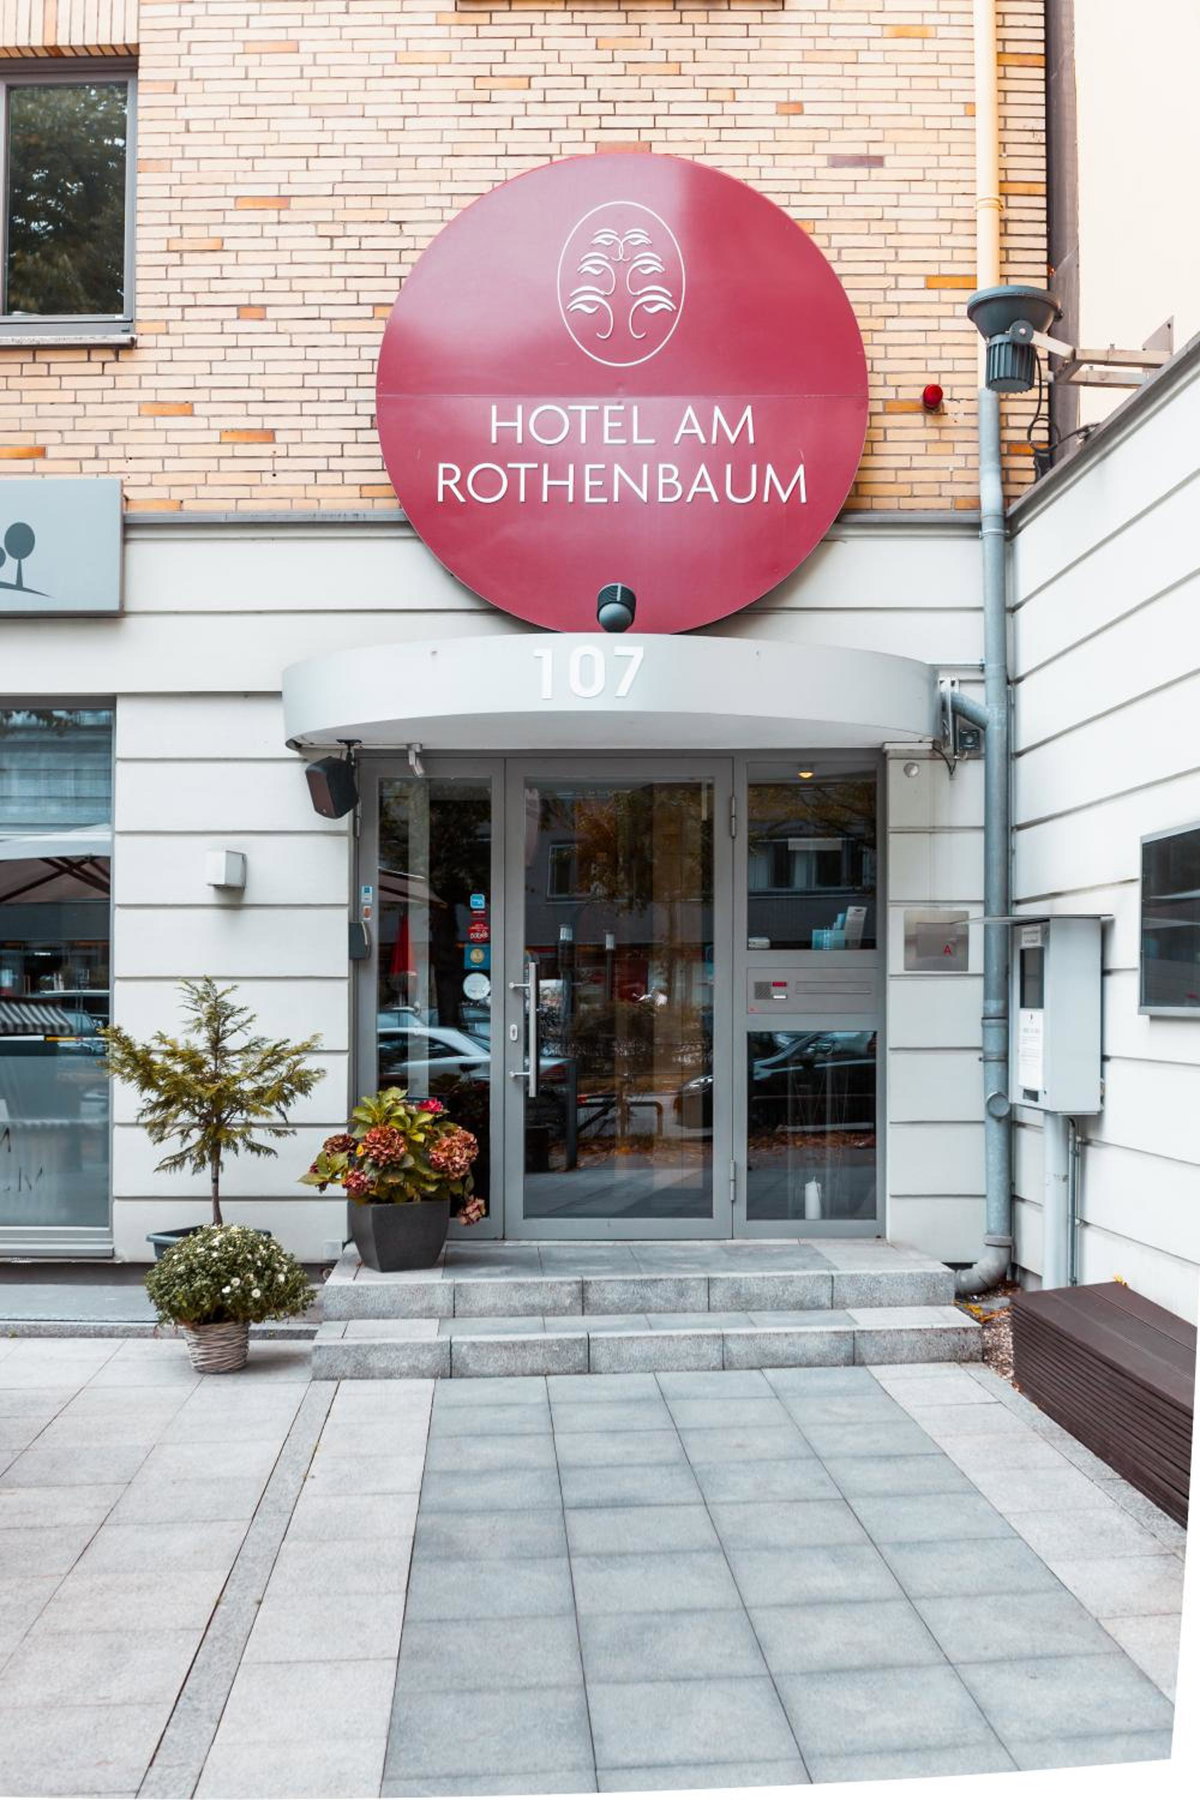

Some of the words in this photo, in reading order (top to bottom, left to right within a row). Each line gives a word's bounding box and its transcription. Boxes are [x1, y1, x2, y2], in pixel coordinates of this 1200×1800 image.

[490, 404, 656, 446] HOTEL
[673, 404, 756, 445] AM
[436, 462, 808, 505] ROTHENBAUM
[532, 645, 645, 700] 107
